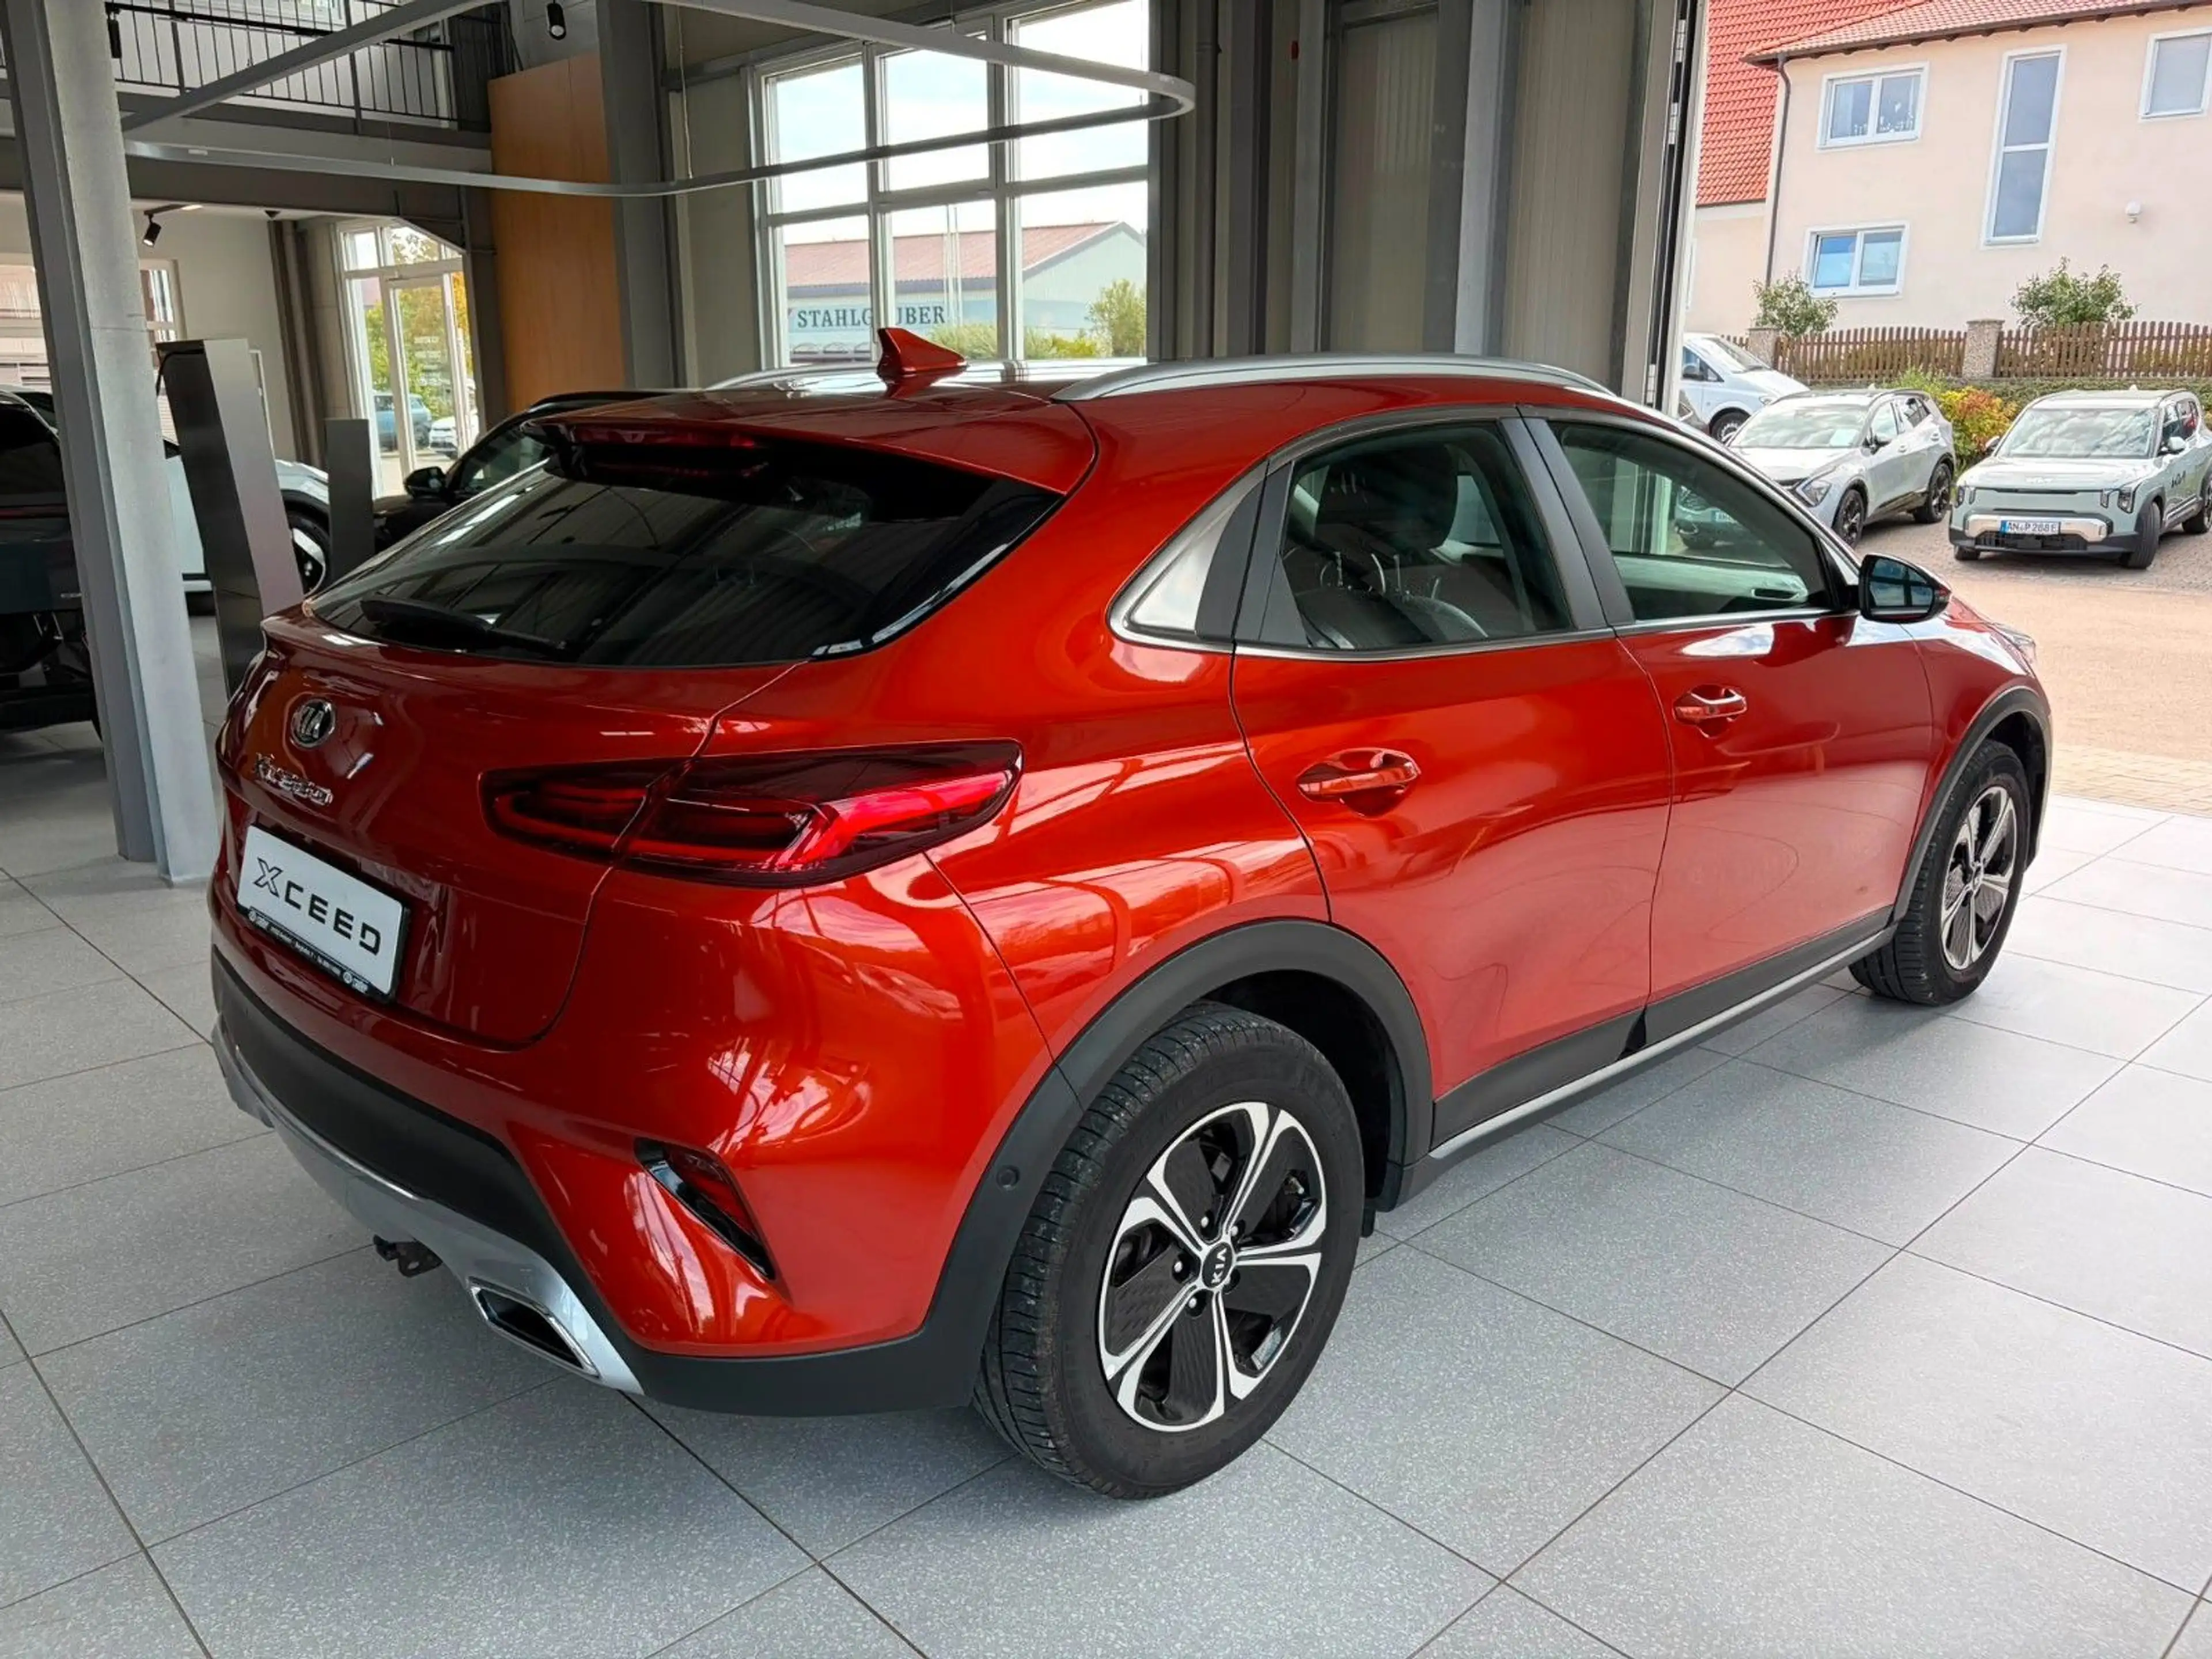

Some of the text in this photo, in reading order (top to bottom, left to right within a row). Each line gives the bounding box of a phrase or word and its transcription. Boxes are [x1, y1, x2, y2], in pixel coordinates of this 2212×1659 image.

[797, 306, 945, 328] STAHLGBER
[253, 857, 381, 956] XCEED
[1211, 1248, 1227, 1284] KIA
